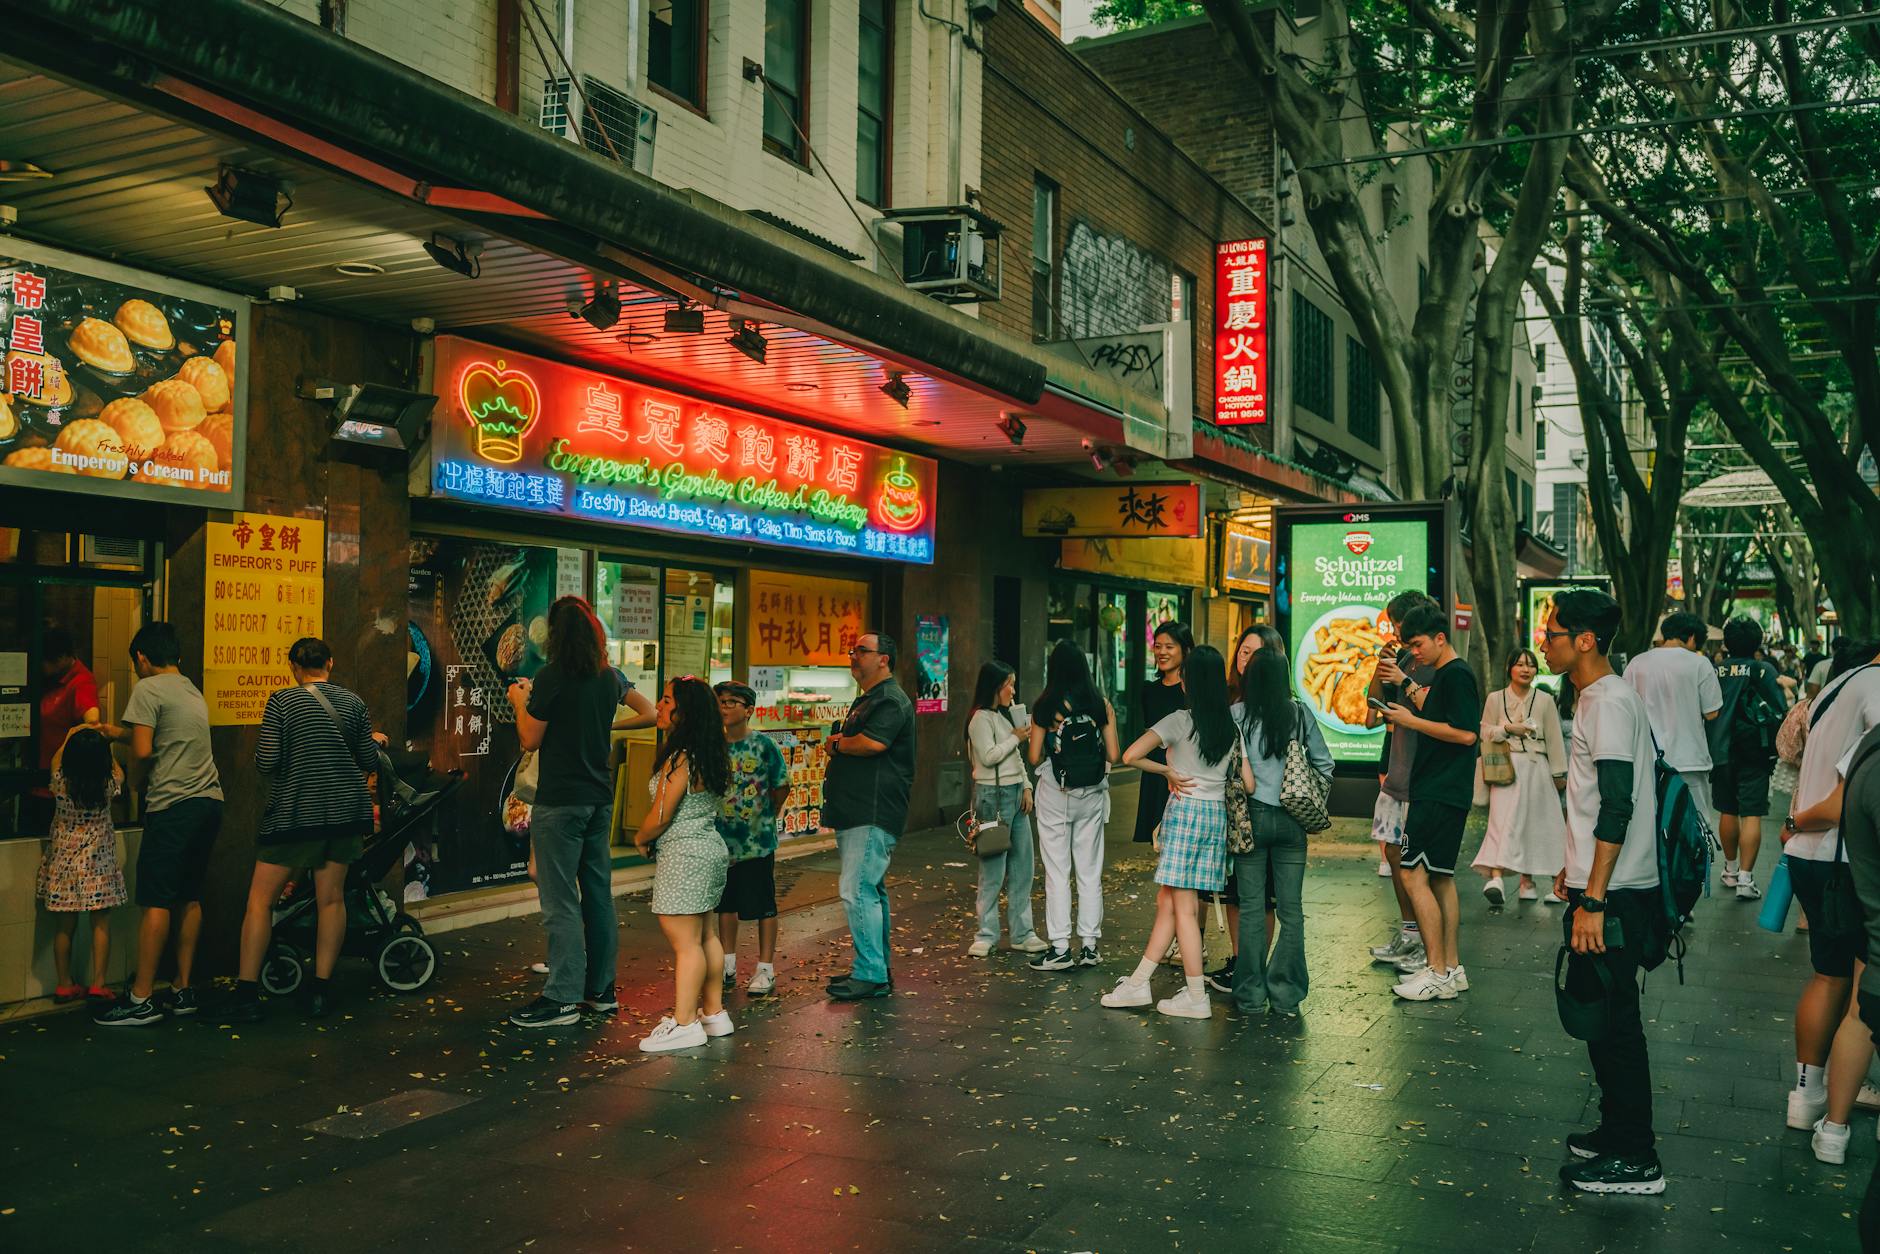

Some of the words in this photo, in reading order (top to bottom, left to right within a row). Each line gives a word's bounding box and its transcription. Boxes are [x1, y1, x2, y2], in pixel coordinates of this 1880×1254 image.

[1229, 241, 1247, 253] LONG
[1248, 240, 1265, 251] DING
[9, 271, 46, 398] 帝皇餅
[1223, 267, 1261, 392] 重慶火鍋
[97, 439, 145, 458] Freshly
[151, 447, 185, 462] Baked
[51, 447, 138, 475] Emperor's
[143, 461, 194, 481] Cream
[200, 468, 230, 485] Puff
[551, 439, 660, 485] Emperor's
[663, 463, 734, 499] Garden
[741, 476, 789, 508] Cakes
[811, 489, 868, 529] Bakery
[582, 491, 625, 516] Freshly
[629, 498, 665, 518] Baked
[706, 509, 726, 533] Egg
[827, 528, 833, 542] &
[232, 520, 301, 554] 帝皇餅
[213, 554, 283, 571] EMPEROR'S
[289, 559, 317, 573] PUFF
[1315, 555, 1404, 573] Schnitzel
[1322, 571, 1338, 587] &
[1342, 571, 1396, 590] Chips
[236, 582, 261, 600] EACH
[1300, 591, 1338, 605] Everyday
[214, 612, 237, 632] $4.00
[240, 614, 258, 632] FOR
[261, 614, 267, 632] 7
[213, 645, 236, 665] $5.00
[240, 647, 257, 665] FOR
[260, 647, 270, 665] 10
[238, 675, 290, 686] CAUTION
[216, 689, 267, 698] EMPEROR'S
[453, 687, 483, 708] 皇冠
[218, 700, 256, 708] FRESHLY
[454, 714, 483, 735] 月餅
[755, 705, 803, 724] 中秋月餅
